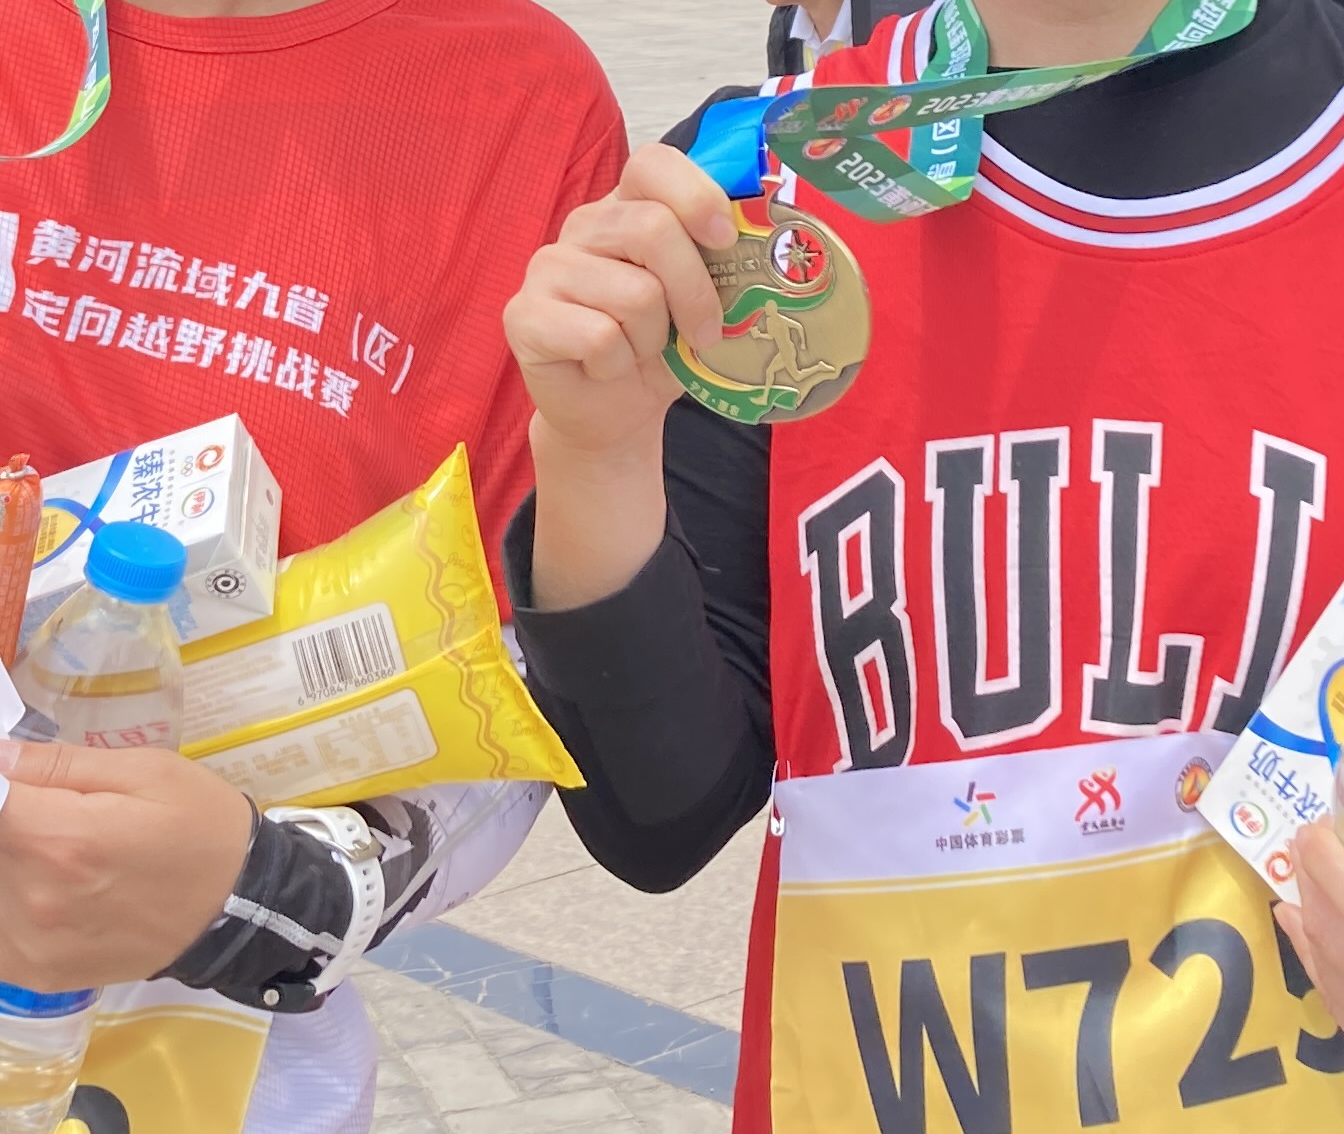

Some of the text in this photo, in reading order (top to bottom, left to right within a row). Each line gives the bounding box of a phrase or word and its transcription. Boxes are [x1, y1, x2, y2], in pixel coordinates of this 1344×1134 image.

[25, 218, 414, 395] 黄河流域九省（区）
[22, 288, 360, 419] 定向越野挑战赛
[130, 447, 164, 527] 臻浓牛
[297, 695, 305, 707] 6
[310, 681, 350, 703] 970847
[1248, 741, 1331, 821] 浓牛奶
[935, 828, 1026, 852] 中国体育彩票
